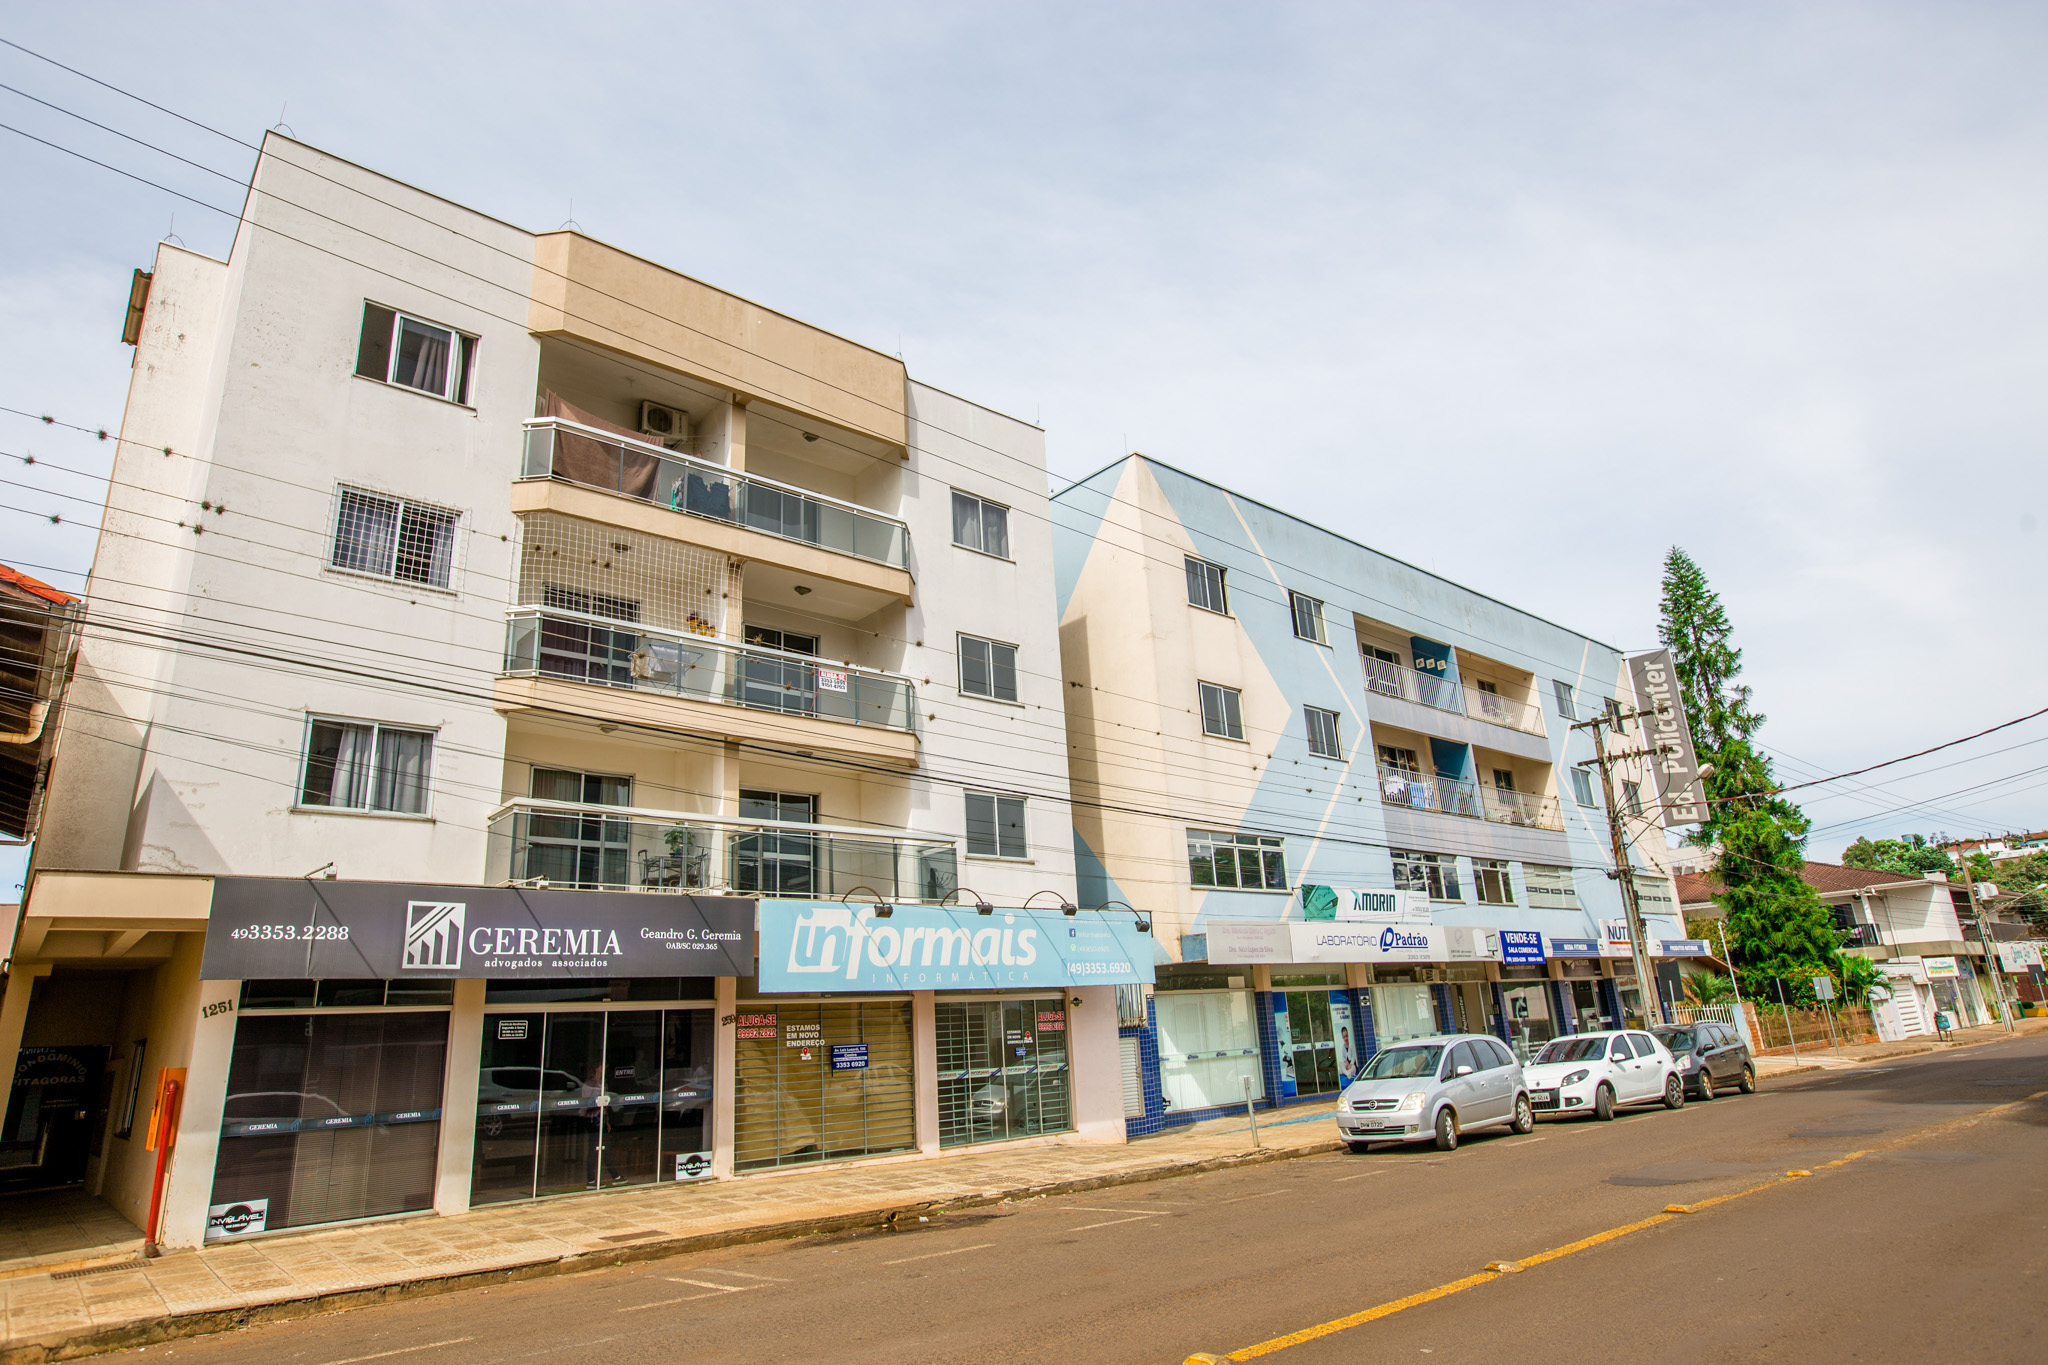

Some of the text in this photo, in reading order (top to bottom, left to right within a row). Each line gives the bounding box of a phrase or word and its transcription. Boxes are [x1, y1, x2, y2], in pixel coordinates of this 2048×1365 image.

[1643, 661, 1700, 822] Ed. Policenter
[640, 927, 742, 941] Geandro G. Geremia
[1316, 932, 1428, 946] LABORATÓRIO Padrão
[1504, 932, 1538, 944] VENDE-SE
[468, 926, 624, 956] GEREMIA
[665, 942, 691, 950] OAB/SC
[1518, 946, 1539, 954] COMERCIAL
[484, 957, 608, 970] advogados associados
[1067, 962, 1131, 977] (49)3353.6920
[872, 970, 1029, 983] INFORMÁTICA
[201, 999, 234, 1019] 1251
[737, 1014, 777, 1027] ALUGA-SE
[1038, 1011, 1065, 1021] ALUGA-SE
[737, 1028, 758, 1039] 99992
[786, 1024, 820, 1032] ESTAMOS
[799, 1031, 819, 1039] NOVO
[786, 1039, 825, 1047] ENDEREÇO
[325, 1117, 352, 1125] GEREMIA
[396, 1111, 421, 1119] GEREMIA
[249, 1123, 278, 1131] GEREMIA
[210, 1212, 263, 1226] INVIOLÁVEL
